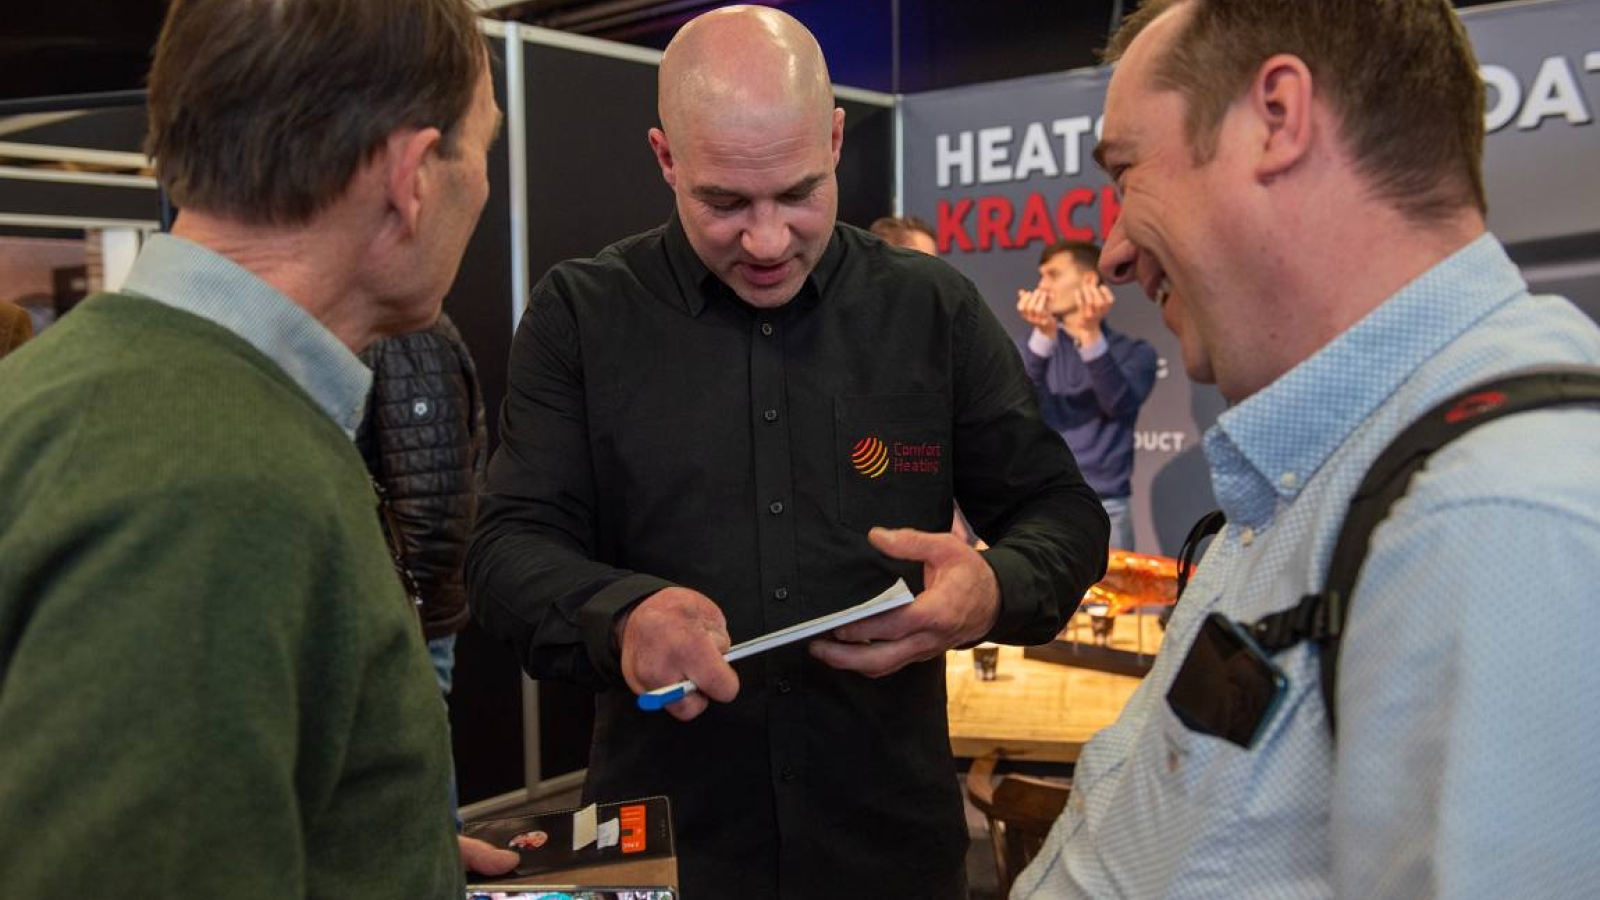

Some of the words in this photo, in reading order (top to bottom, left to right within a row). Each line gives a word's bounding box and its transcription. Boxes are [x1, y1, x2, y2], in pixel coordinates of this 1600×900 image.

[936, 115, 1104, 187] HEAT
[1478, 50, 1600, 129] DA
[893, 442, 941, 457] Comfort
[893, 457, 939, 474] Heating
